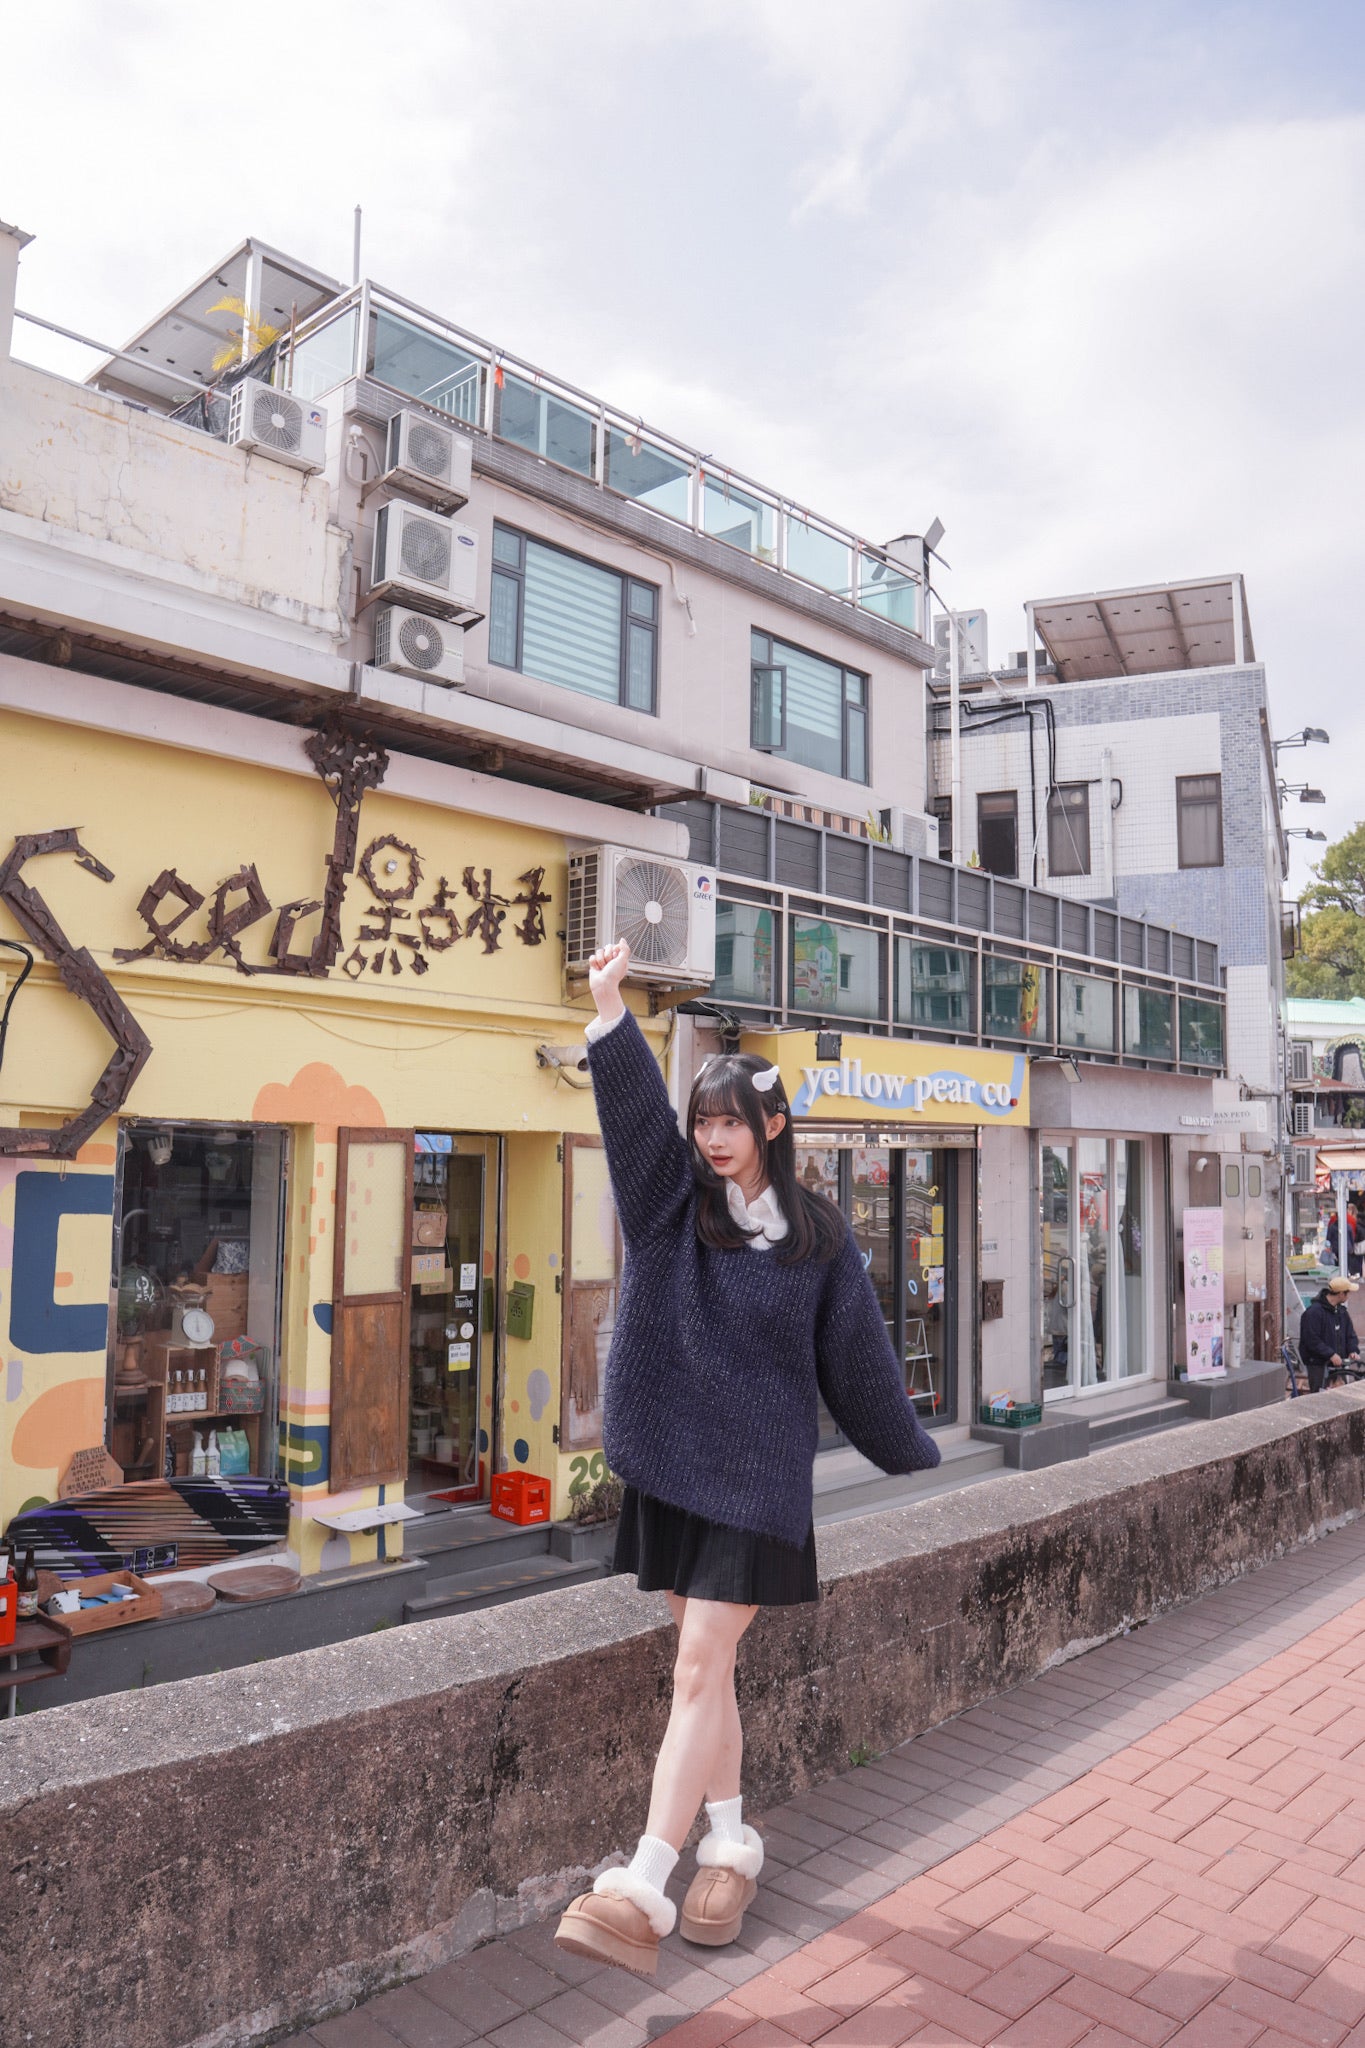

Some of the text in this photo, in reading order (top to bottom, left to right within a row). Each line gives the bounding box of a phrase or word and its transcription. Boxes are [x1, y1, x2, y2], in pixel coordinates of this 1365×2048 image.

[694, 892, 713, 901] GREE
[0, 713, 389, 1158] Seed
[800, 1057, 1018, 1112] yellow pear co.
